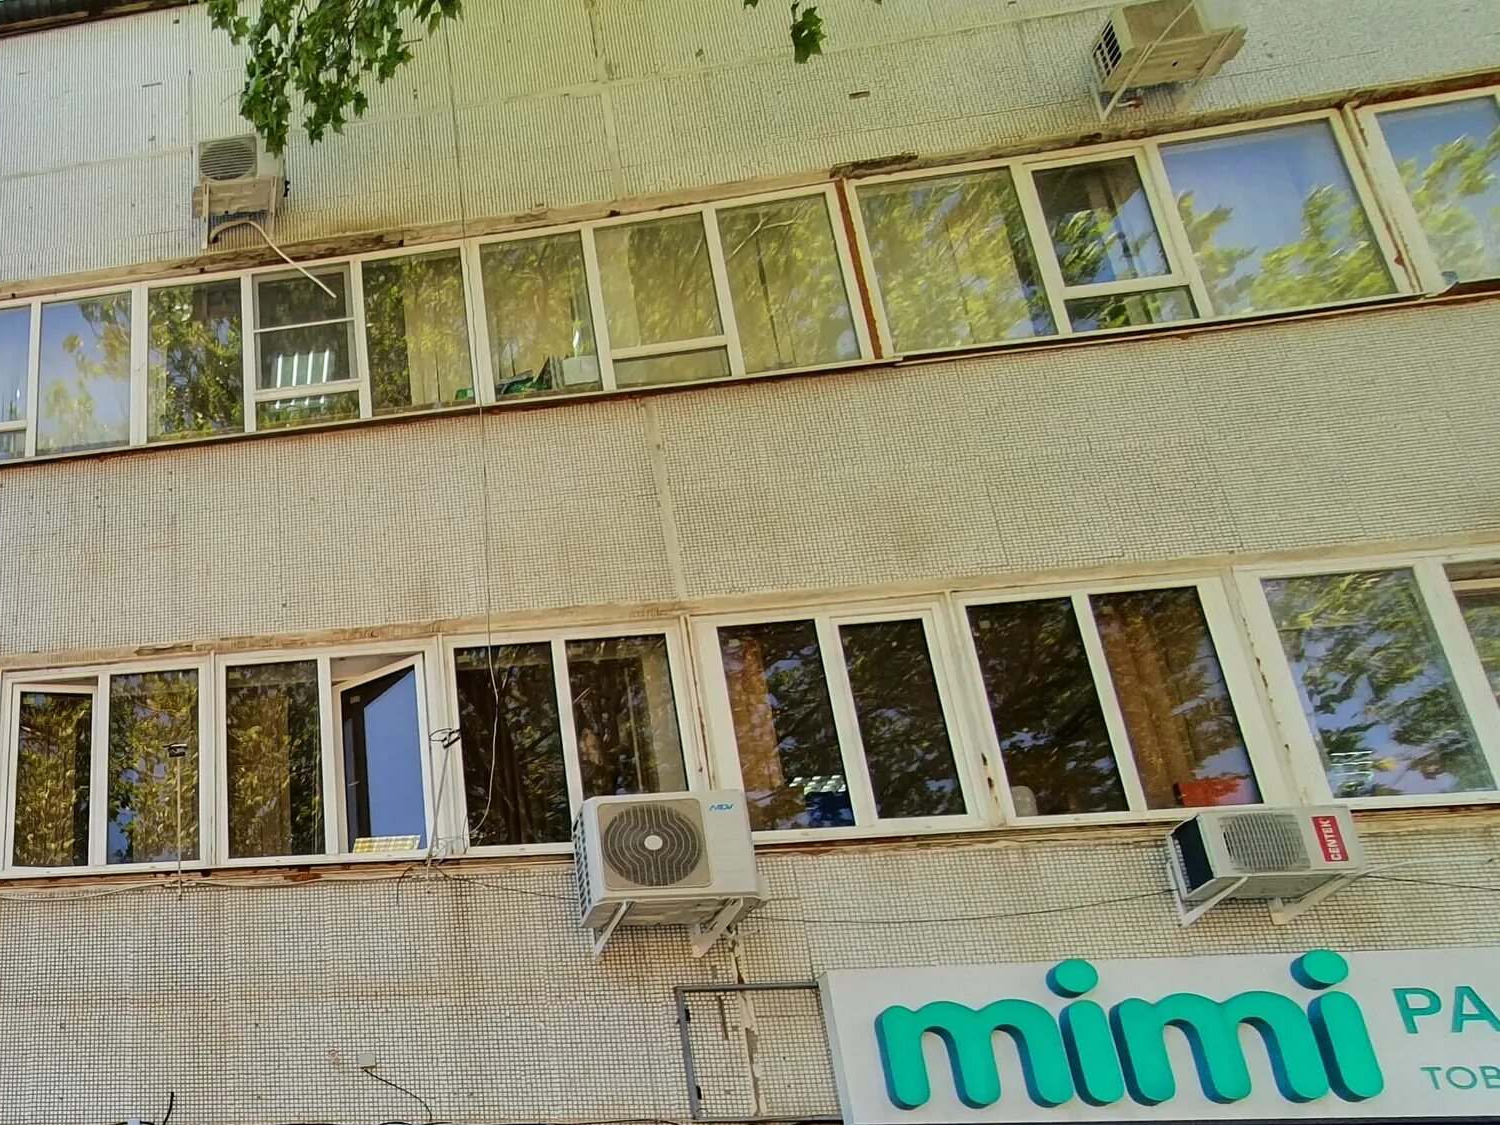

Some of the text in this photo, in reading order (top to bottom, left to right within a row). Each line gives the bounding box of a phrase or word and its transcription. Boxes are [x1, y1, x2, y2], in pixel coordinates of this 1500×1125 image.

[1318, 817, 1343, 861] CENTEK
[874, 949, 1386, 1110] mimi
[1391, 985, 1500, 1034] PA
